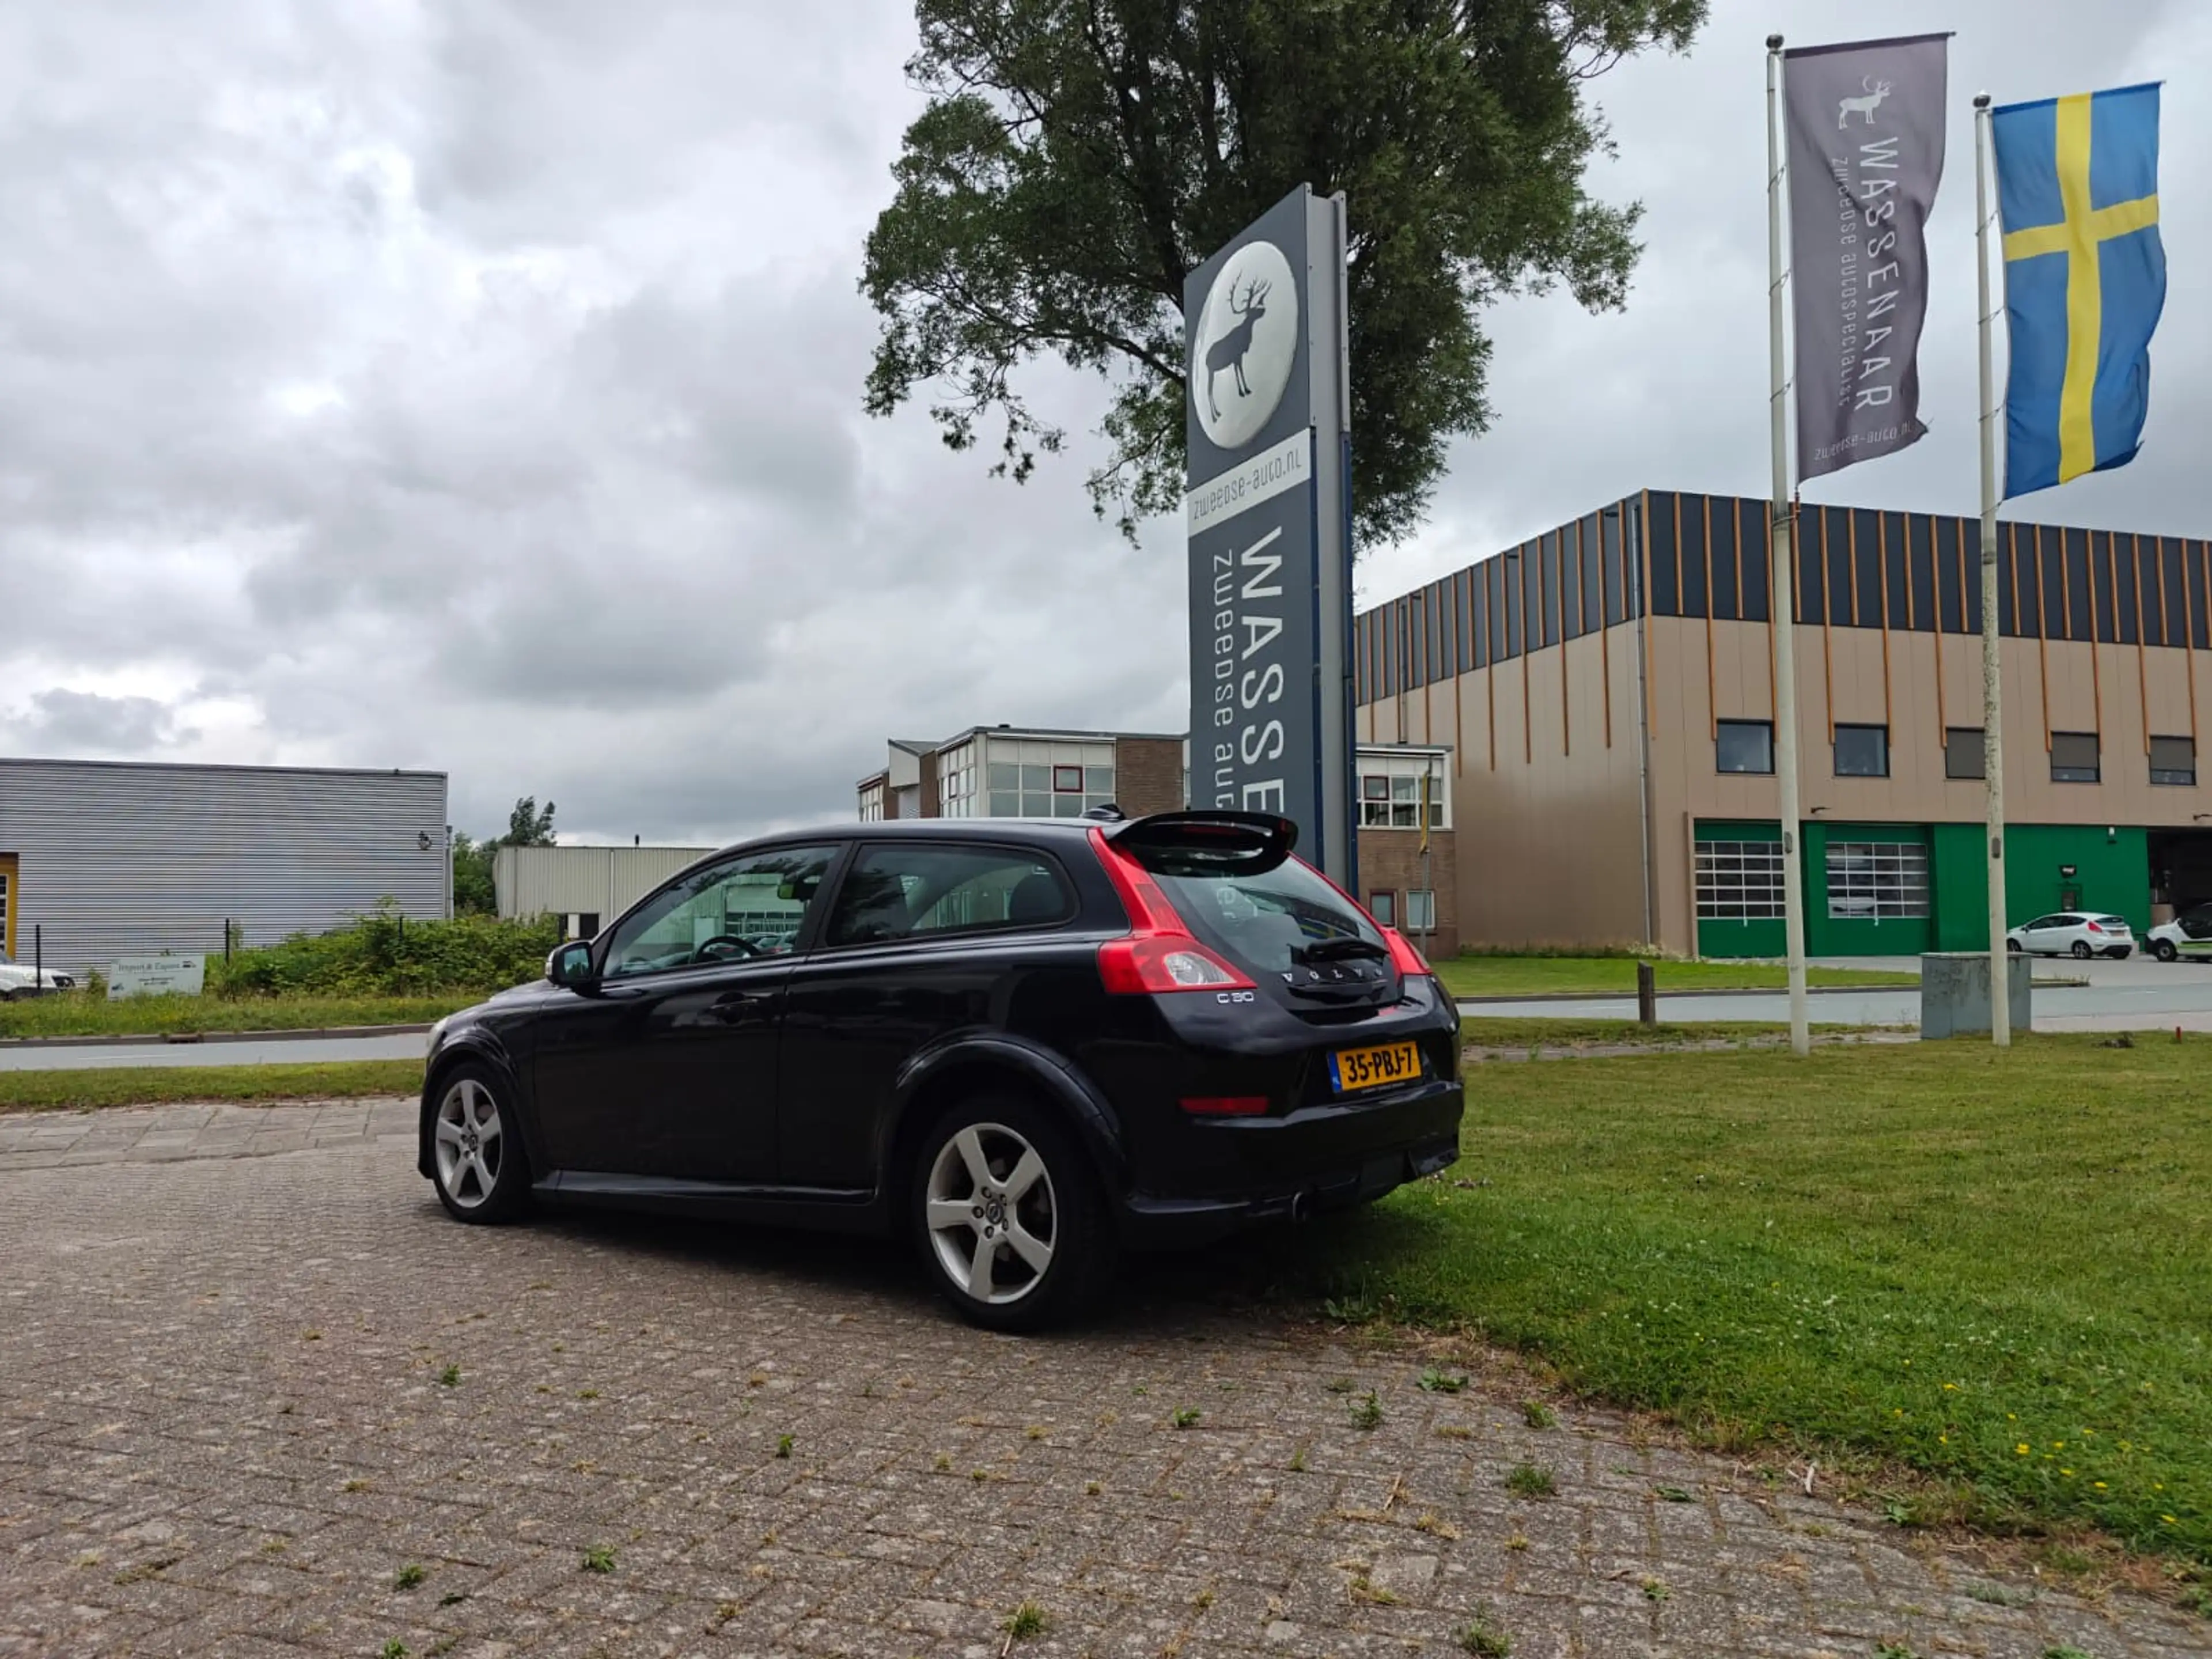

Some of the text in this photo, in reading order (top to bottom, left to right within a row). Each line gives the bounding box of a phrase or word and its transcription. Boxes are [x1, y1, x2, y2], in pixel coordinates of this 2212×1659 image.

[1854, 137, 1899, 411] WASSENAAR
[1213, 548, 1234, 808] zweedse aut
[1241, 525, 1284, 813] WASSE
[1216, 991, 1255, 1004] C30
[1281, 967, 1382, 983] VOLVO
[1345, 1046, 1411, 1084] 35-PBJ-7
